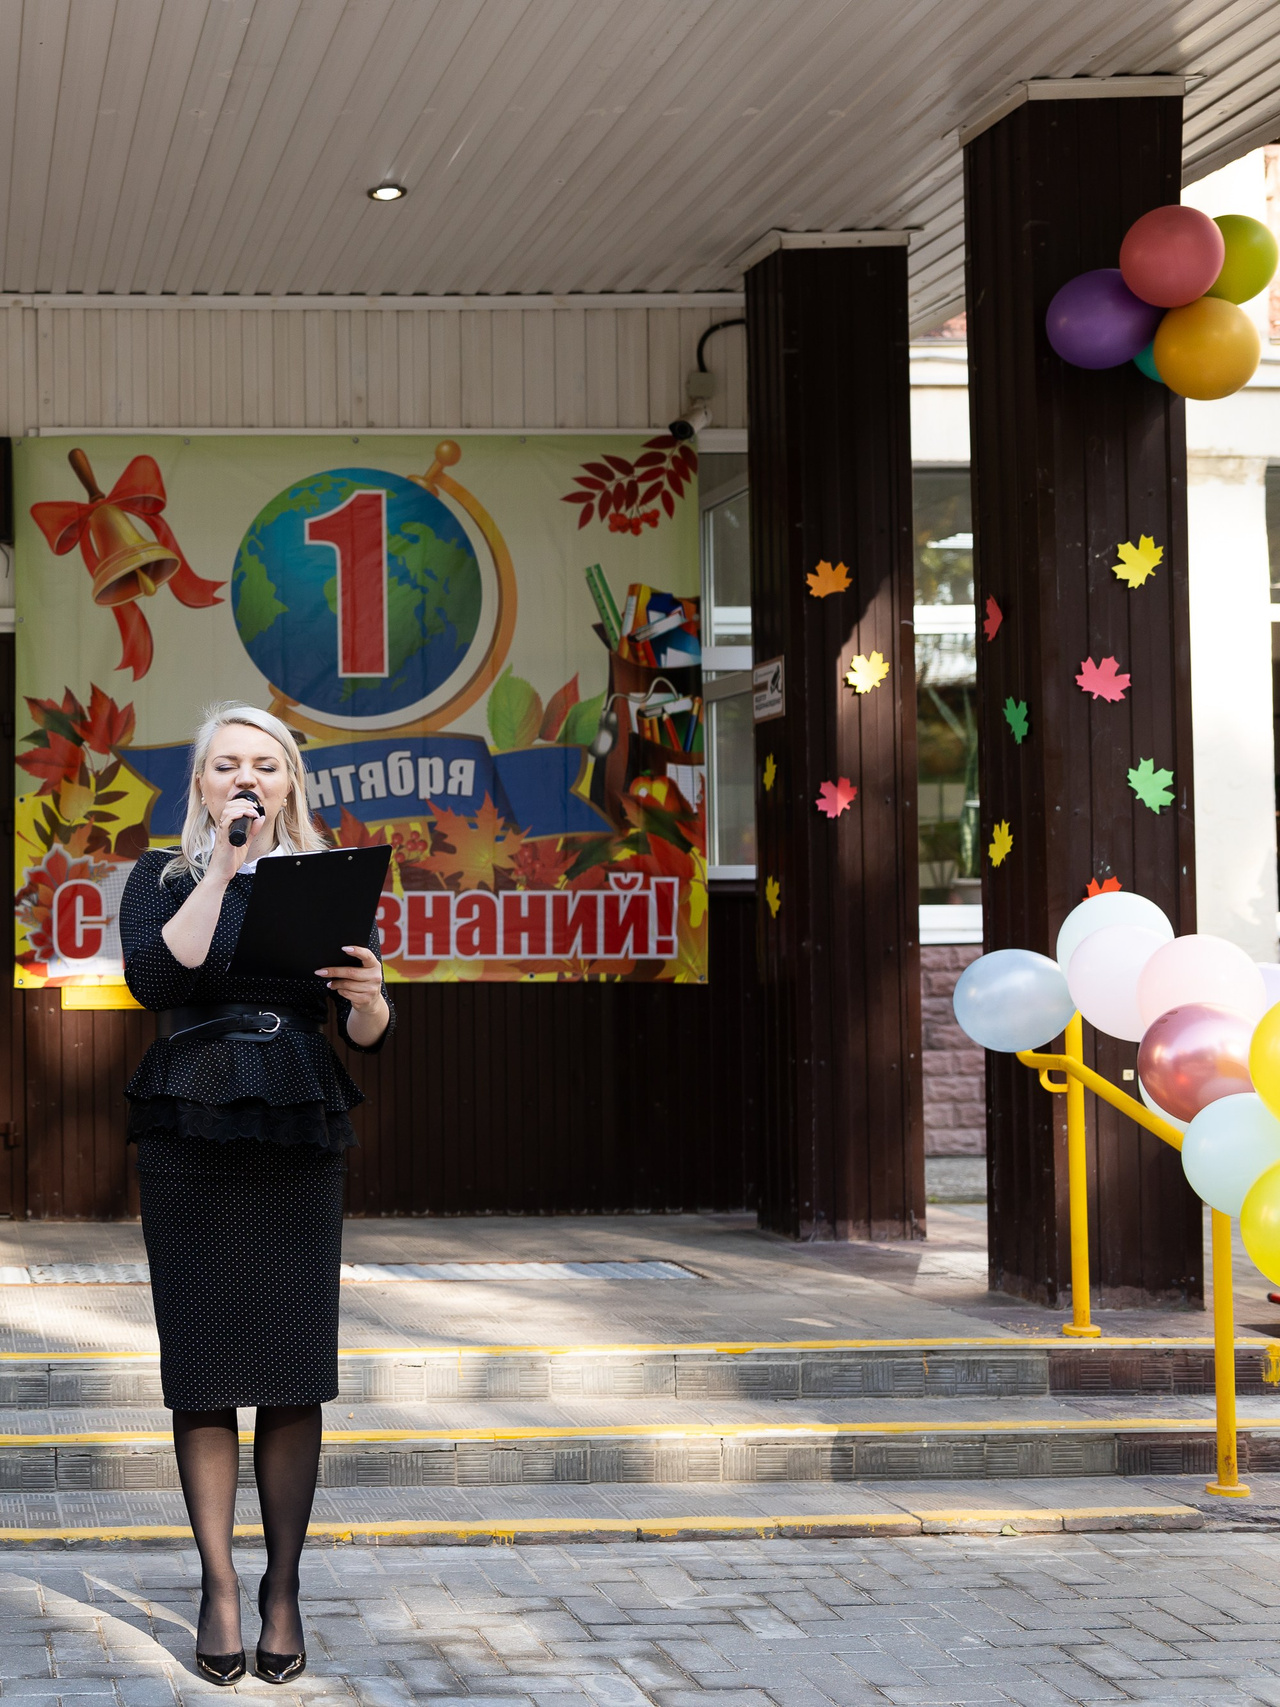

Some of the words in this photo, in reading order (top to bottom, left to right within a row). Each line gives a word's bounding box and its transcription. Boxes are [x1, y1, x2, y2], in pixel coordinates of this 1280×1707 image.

[303, 488, 390, 679] 1
[307, 750, 476, 810] нтября
[376, 871, 680, 961] знаний!
